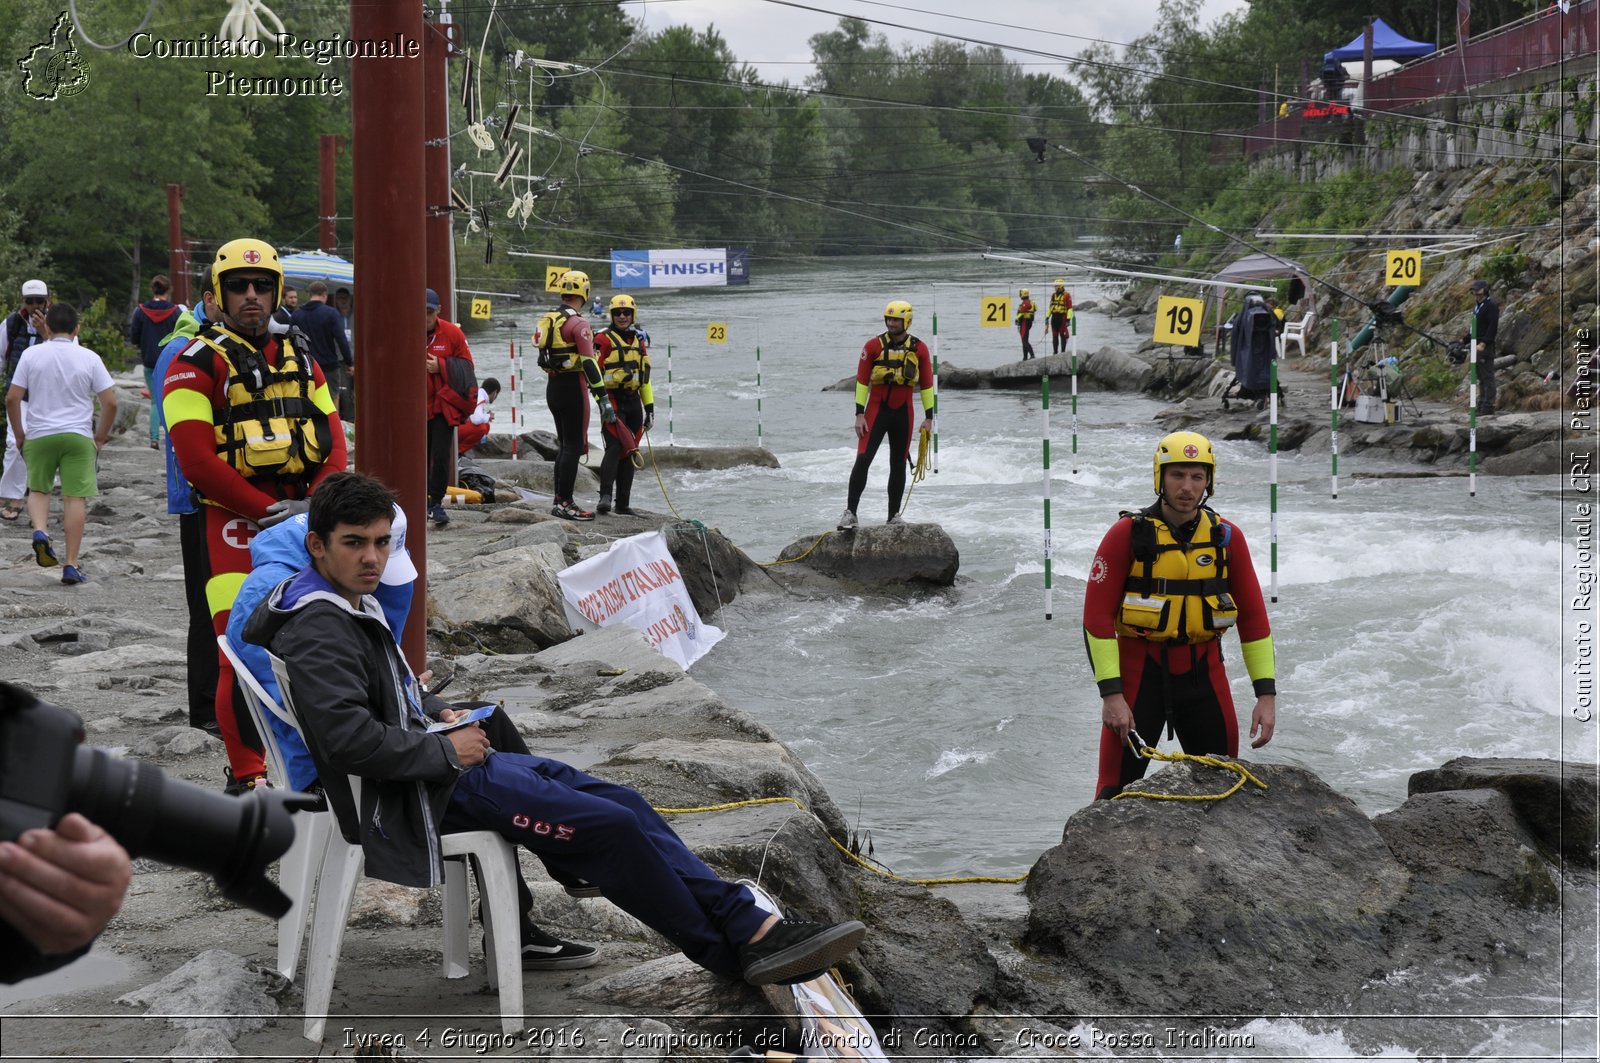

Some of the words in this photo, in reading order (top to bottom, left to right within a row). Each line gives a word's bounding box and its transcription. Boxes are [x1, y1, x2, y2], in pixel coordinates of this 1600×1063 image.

[652, 263, 723, 275] FINISH
[1392, 256, 1416, 278] 20
[474, 303, 488, 315] 24
[986, 302, 1007, 322] 21
[1166, 306, 1193, 334] 19
[710, 326, 724, 340] 23
